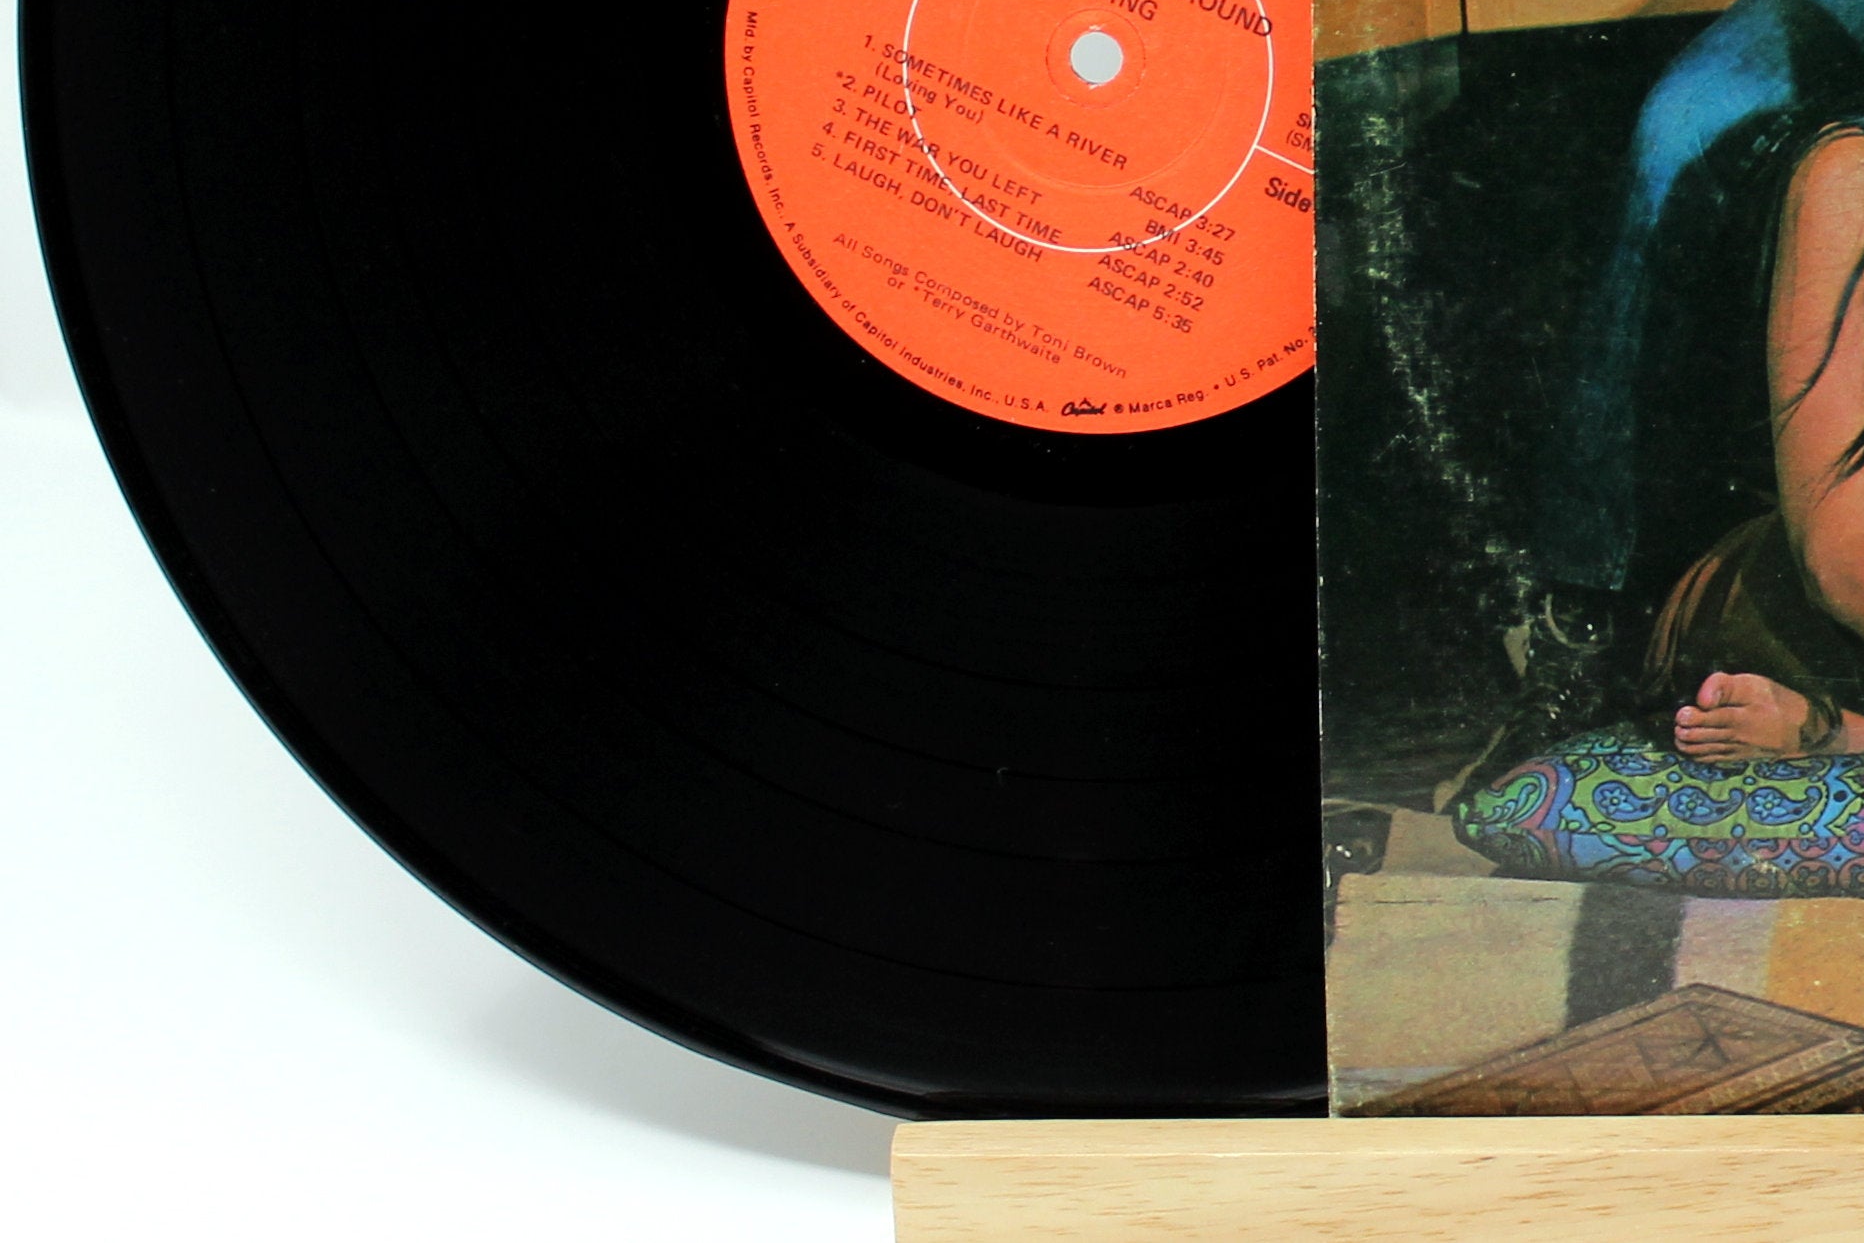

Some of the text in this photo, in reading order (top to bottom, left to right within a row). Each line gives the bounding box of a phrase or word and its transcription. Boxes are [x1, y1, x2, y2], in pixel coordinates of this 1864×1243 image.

[742, 46, 754, 62] by
[742, 66, 760, 118] Capitol
[863, 85, 922, 117] PILOT
[864, 34, 1128, 170] 1. SOMETIMES LIKE A RIVER
[832, 99, 1043, 206] 3. THE WAR YOU LEFT
[811, 143, 1044, 262] 5. LAUGH, DON'T LAUGH
[1130, 186, 1236, 243] ASCAP 3:27
[1264, 177, 1313, 213] Side
[793, 233, 842, 299] Subsidiary
[1108, 231, 1215, 288] ASCAP 2:40
[1145, 220, 1226, 266] BMI 3:45
[833, 233, 1127, 379] All Songs Composed by Toni Brown
[842, 298, 856, 313] of
[1088, 276, 1194, 333] ASCAP 5:35
[1098, 254, 1204, 311] ASCAP 2:52
[855, 312, 898, 349] Capitol
